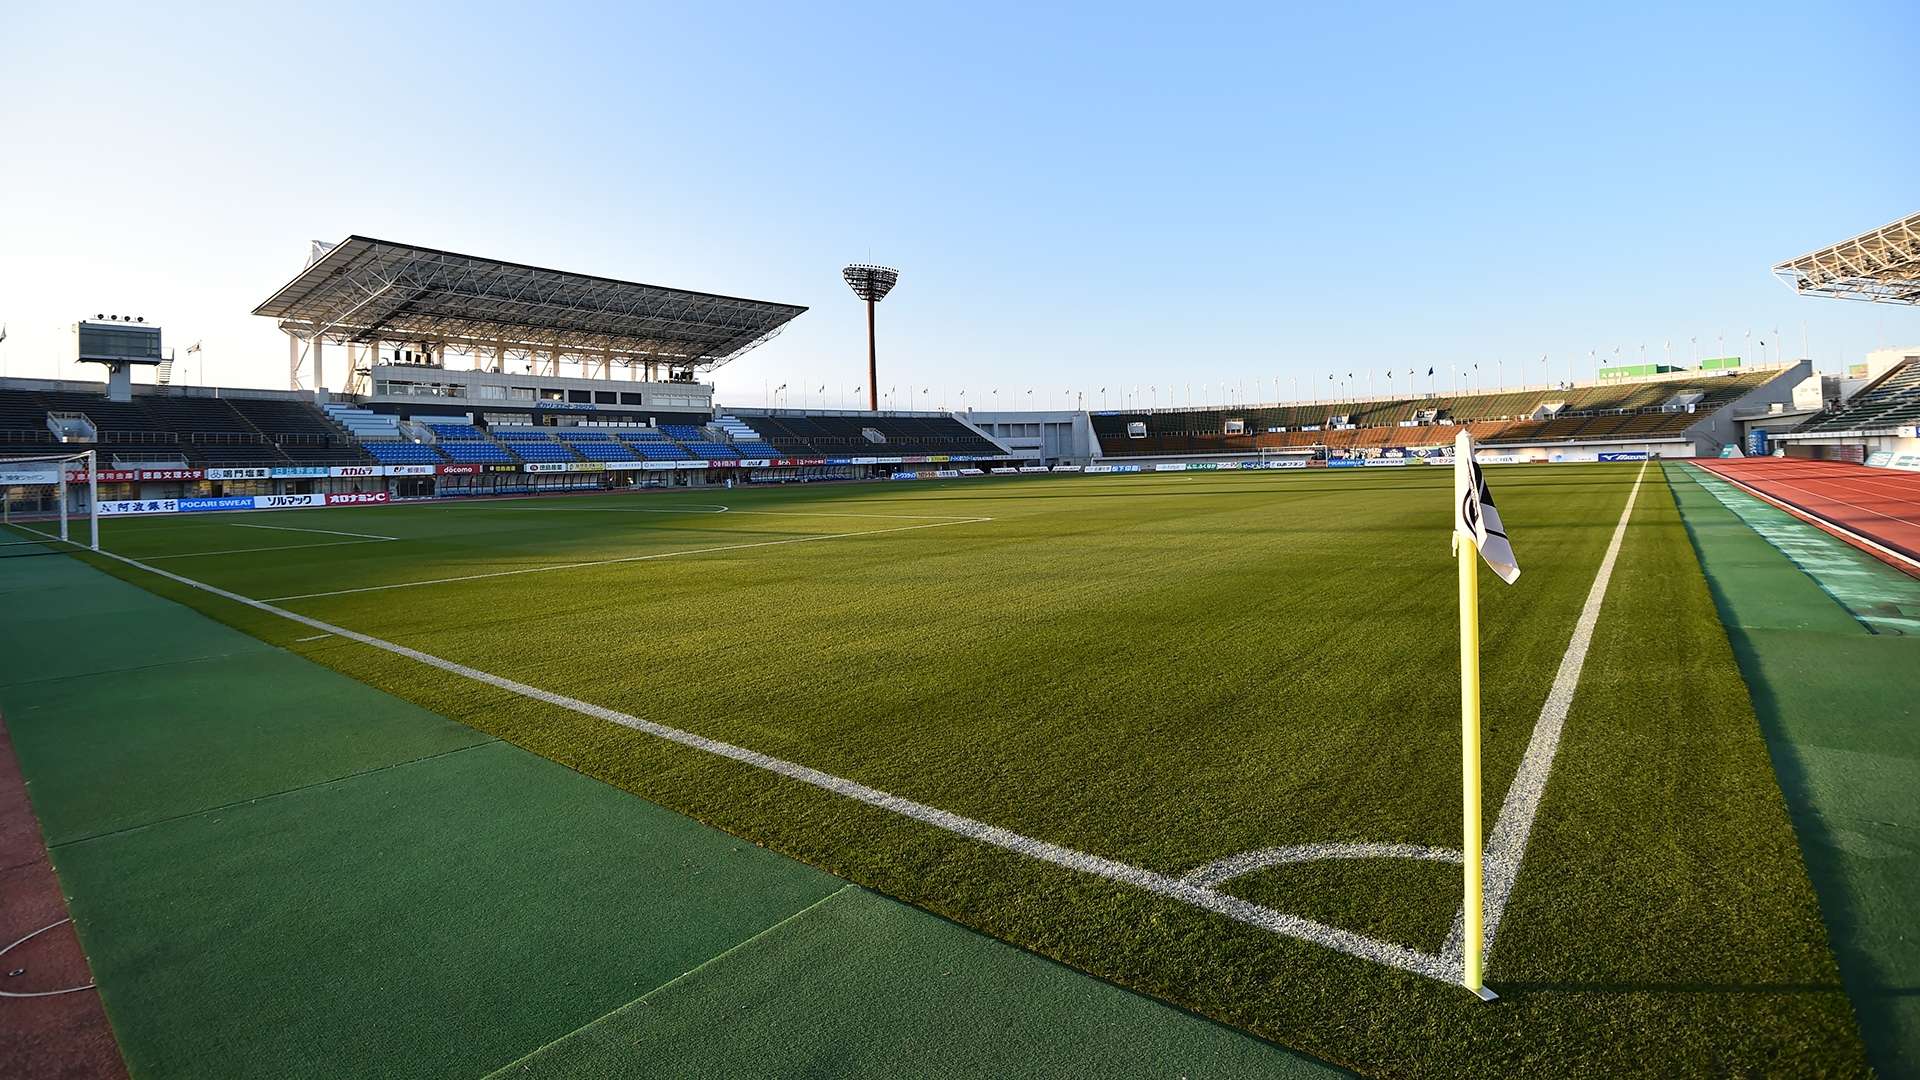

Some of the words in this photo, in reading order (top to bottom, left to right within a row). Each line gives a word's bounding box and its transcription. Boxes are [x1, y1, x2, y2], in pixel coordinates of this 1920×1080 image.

[340, 467, 373, 476] オカムラ
[444, 465, 473, 473] docomo
[142, 470, 201, 480] 徳島文理大学
[268, 496, 312, 506] ソルマック
[329, 493, 386, 503] オロナミンC
[117, 501, 176, 512] 阿波銀行
[180, 501, 217, 509] POCARI
[219, 499, 252, 507] SWEAT
